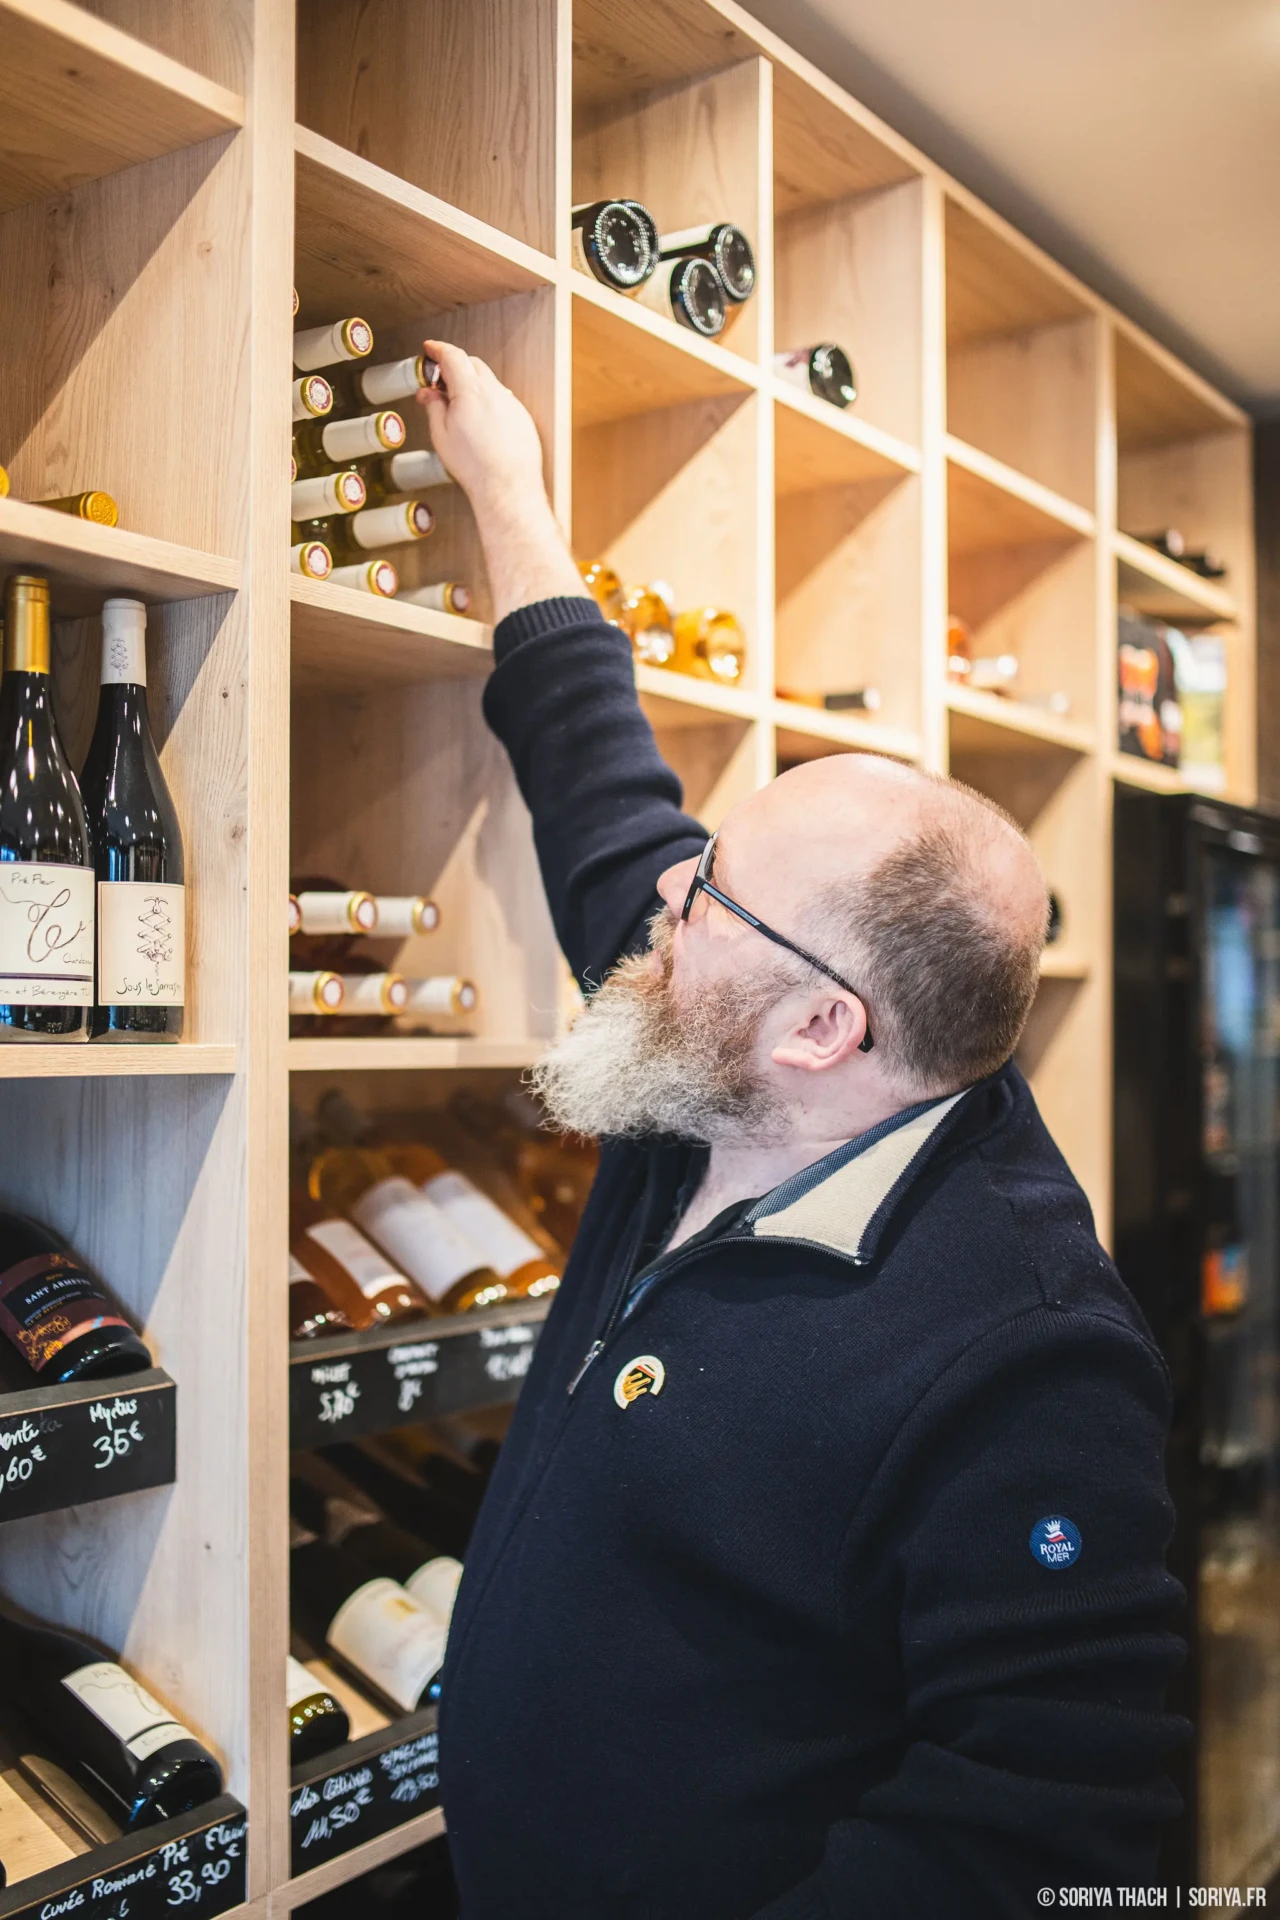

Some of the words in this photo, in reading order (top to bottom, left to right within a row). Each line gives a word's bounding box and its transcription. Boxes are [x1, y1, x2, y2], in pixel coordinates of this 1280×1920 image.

[116, 976, 142, 996] Sous
[145, 977, 154, 991] le
[24, 1285, 50, 1305] SANT
[1040, 1541, 1075, 1555] ROYAL
[1046, 1552, 1070, 1563] MER
[40, 1889, 85, 1920] Cuvée
[158, 1838, 190, 1871] Pré
